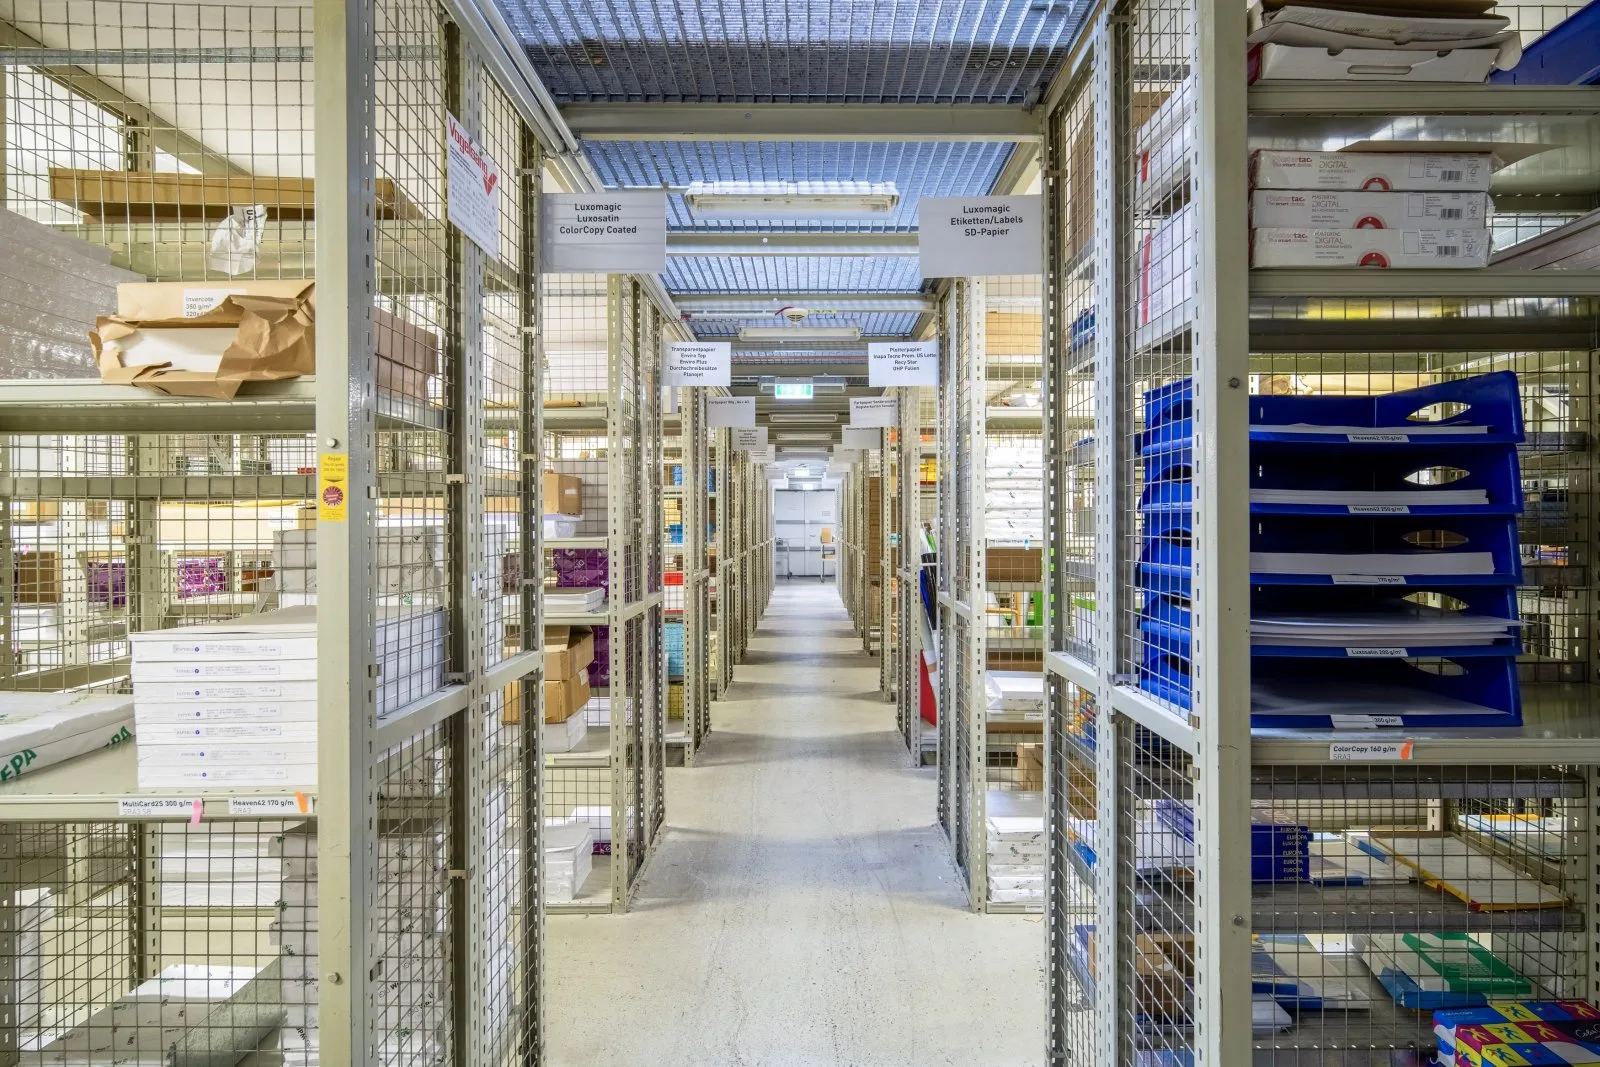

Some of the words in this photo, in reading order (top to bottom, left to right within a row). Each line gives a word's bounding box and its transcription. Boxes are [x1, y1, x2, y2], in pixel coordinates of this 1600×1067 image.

[448, 116, 488, 180] Vogelsang
[574, 203, 622, 212] Luxomagic
[963, 205, 1010, 214] Luxomagic
[951, 216, 1023, 226] Etiketten/Labels
[560, 226, 604, 235] ColorCopy
[965, 228, 1009, 237] SD-Papier
